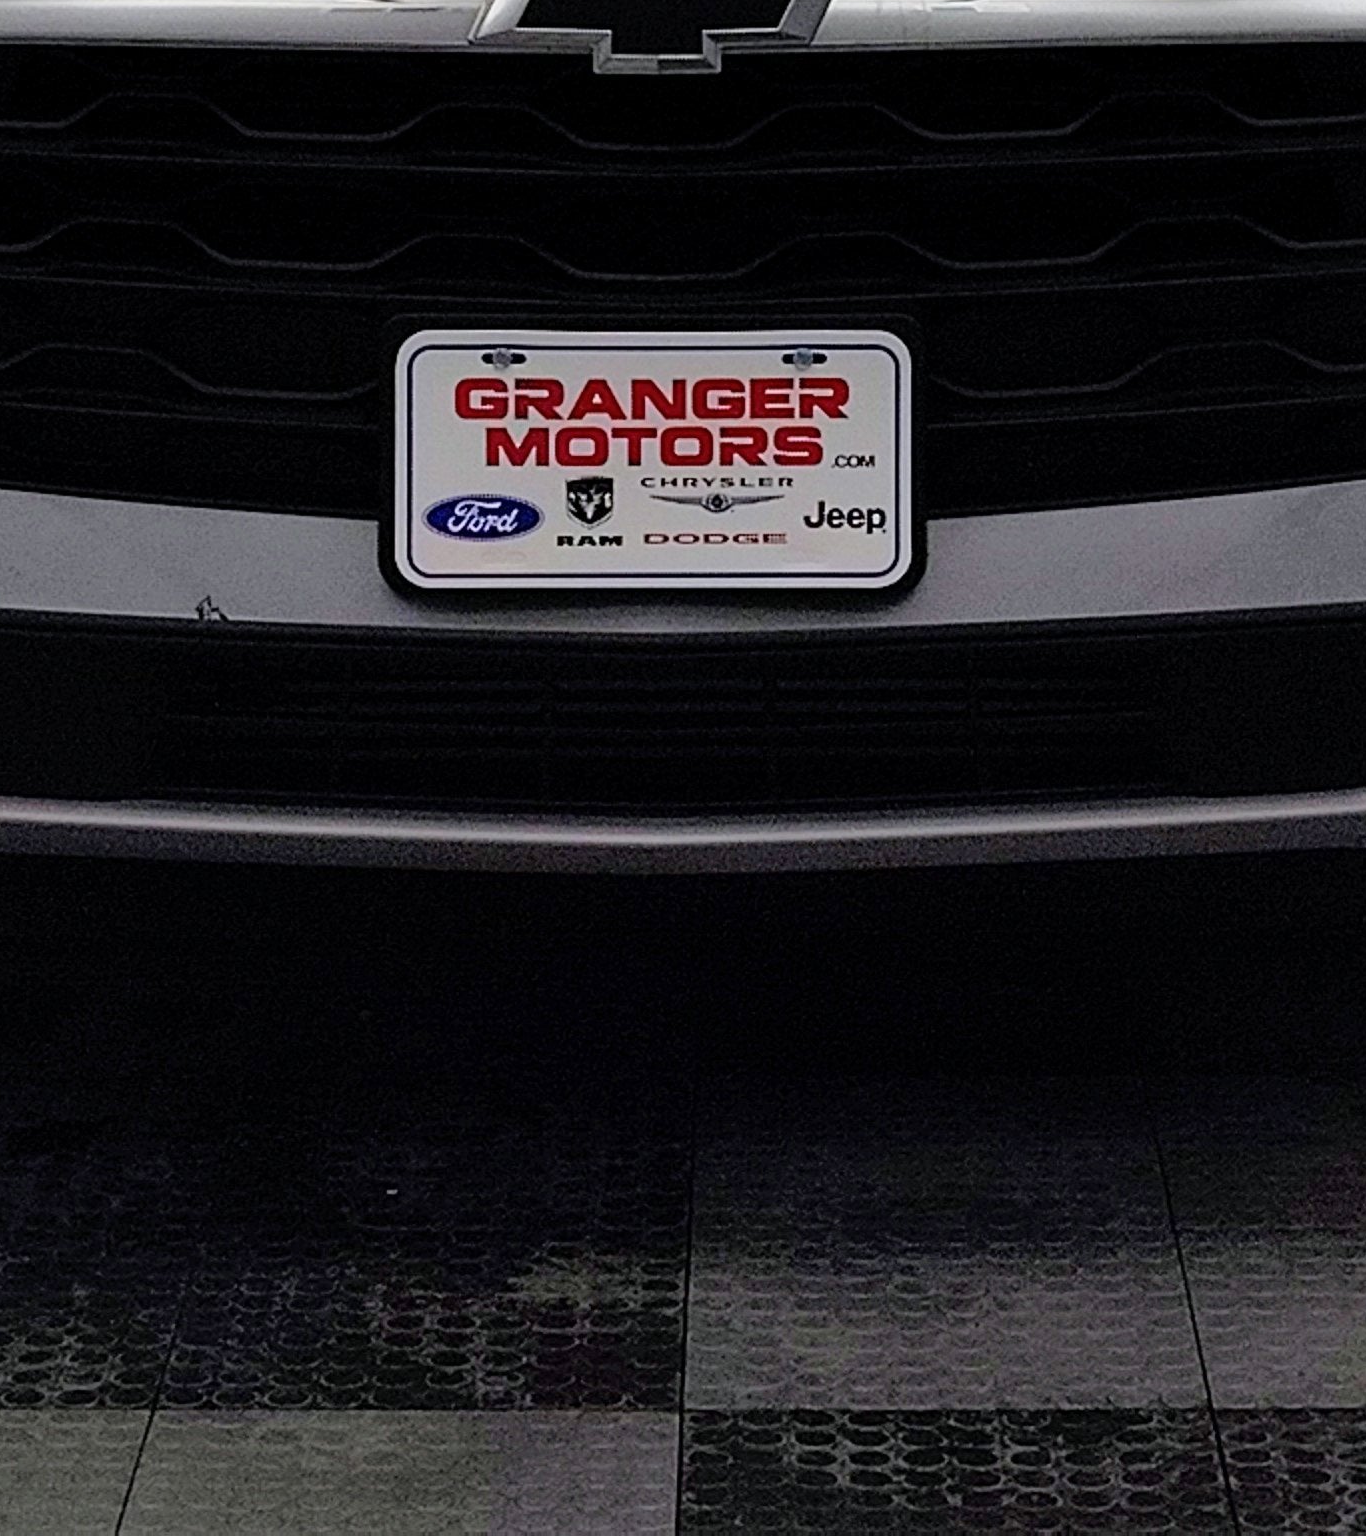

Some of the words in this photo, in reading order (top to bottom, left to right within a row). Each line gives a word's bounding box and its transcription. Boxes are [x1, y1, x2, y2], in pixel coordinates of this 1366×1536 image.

[454, 378, 850, 420] GRANGER
[485, 426, 823, 467] MOTORS
[830, 454, 875, 468] .COM
[640, 477, 794, 488] CHRYSLER
[447, 500, 519, 533] Ford
[803, 500, 887, 534] Jeep
[556, 535, 623, 547] RAM
[643, 533, 788, 545] DODGE
